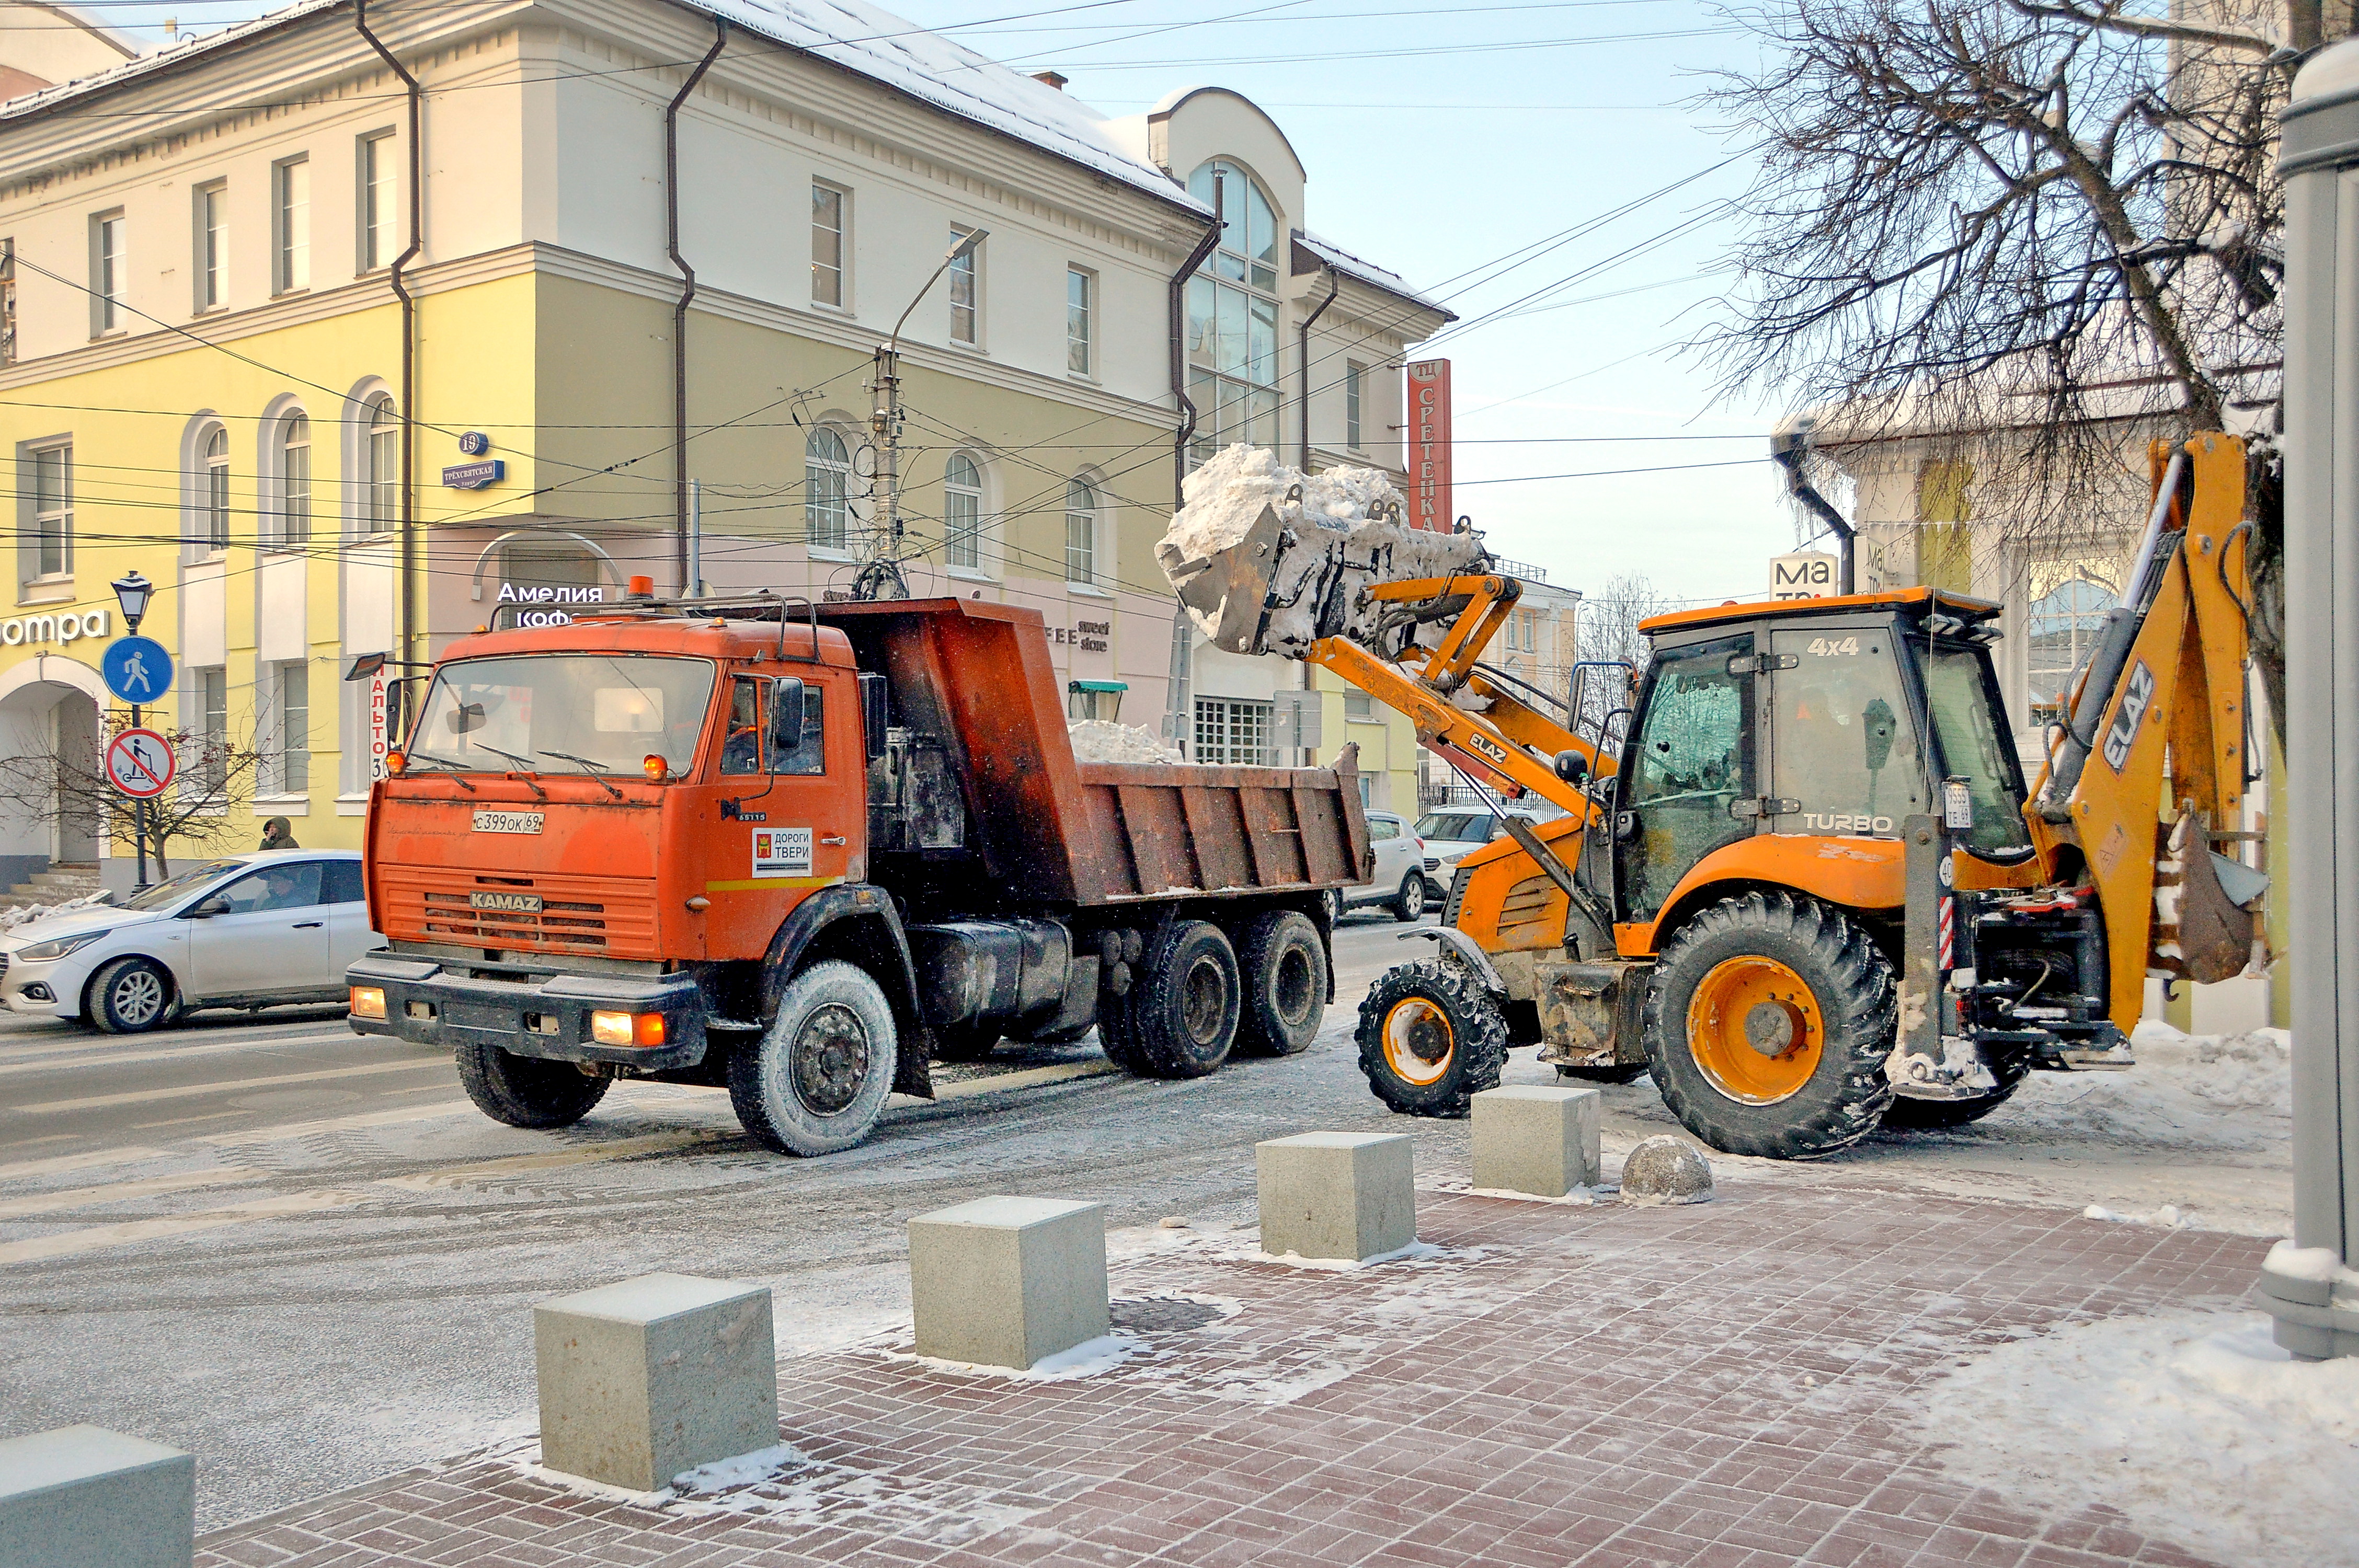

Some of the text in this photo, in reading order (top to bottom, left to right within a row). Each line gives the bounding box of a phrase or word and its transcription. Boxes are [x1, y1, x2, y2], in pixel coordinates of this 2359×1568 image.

[1416, 363, 1437, 377] ТЦ
[463, 435, 476, 451] 19
[1418, 387, 1436, 532] СРЕТЕНКА
[444, 466, 493, 481] ТРЁХСВЯТСКАЯ
[497, 582, 602, 602] Амелия
[517, 609, 581, 627] коф
[1045, 627, 1077, 644] FEE
[1807, 637, 1859, 656] 4x4
[2104, 662, 2152, 768] ELAZ
[1469, 733, 1506, 763] ELAZ
[526, 815, 539, 827] 69
[1804, 813, 1892, 832] TURBO
[775, 834, 809, 845] ДОРОГИ
[775, 847, 809, 858] ТВЕРИ
[472, 894, 539, 911] KAMAZ
